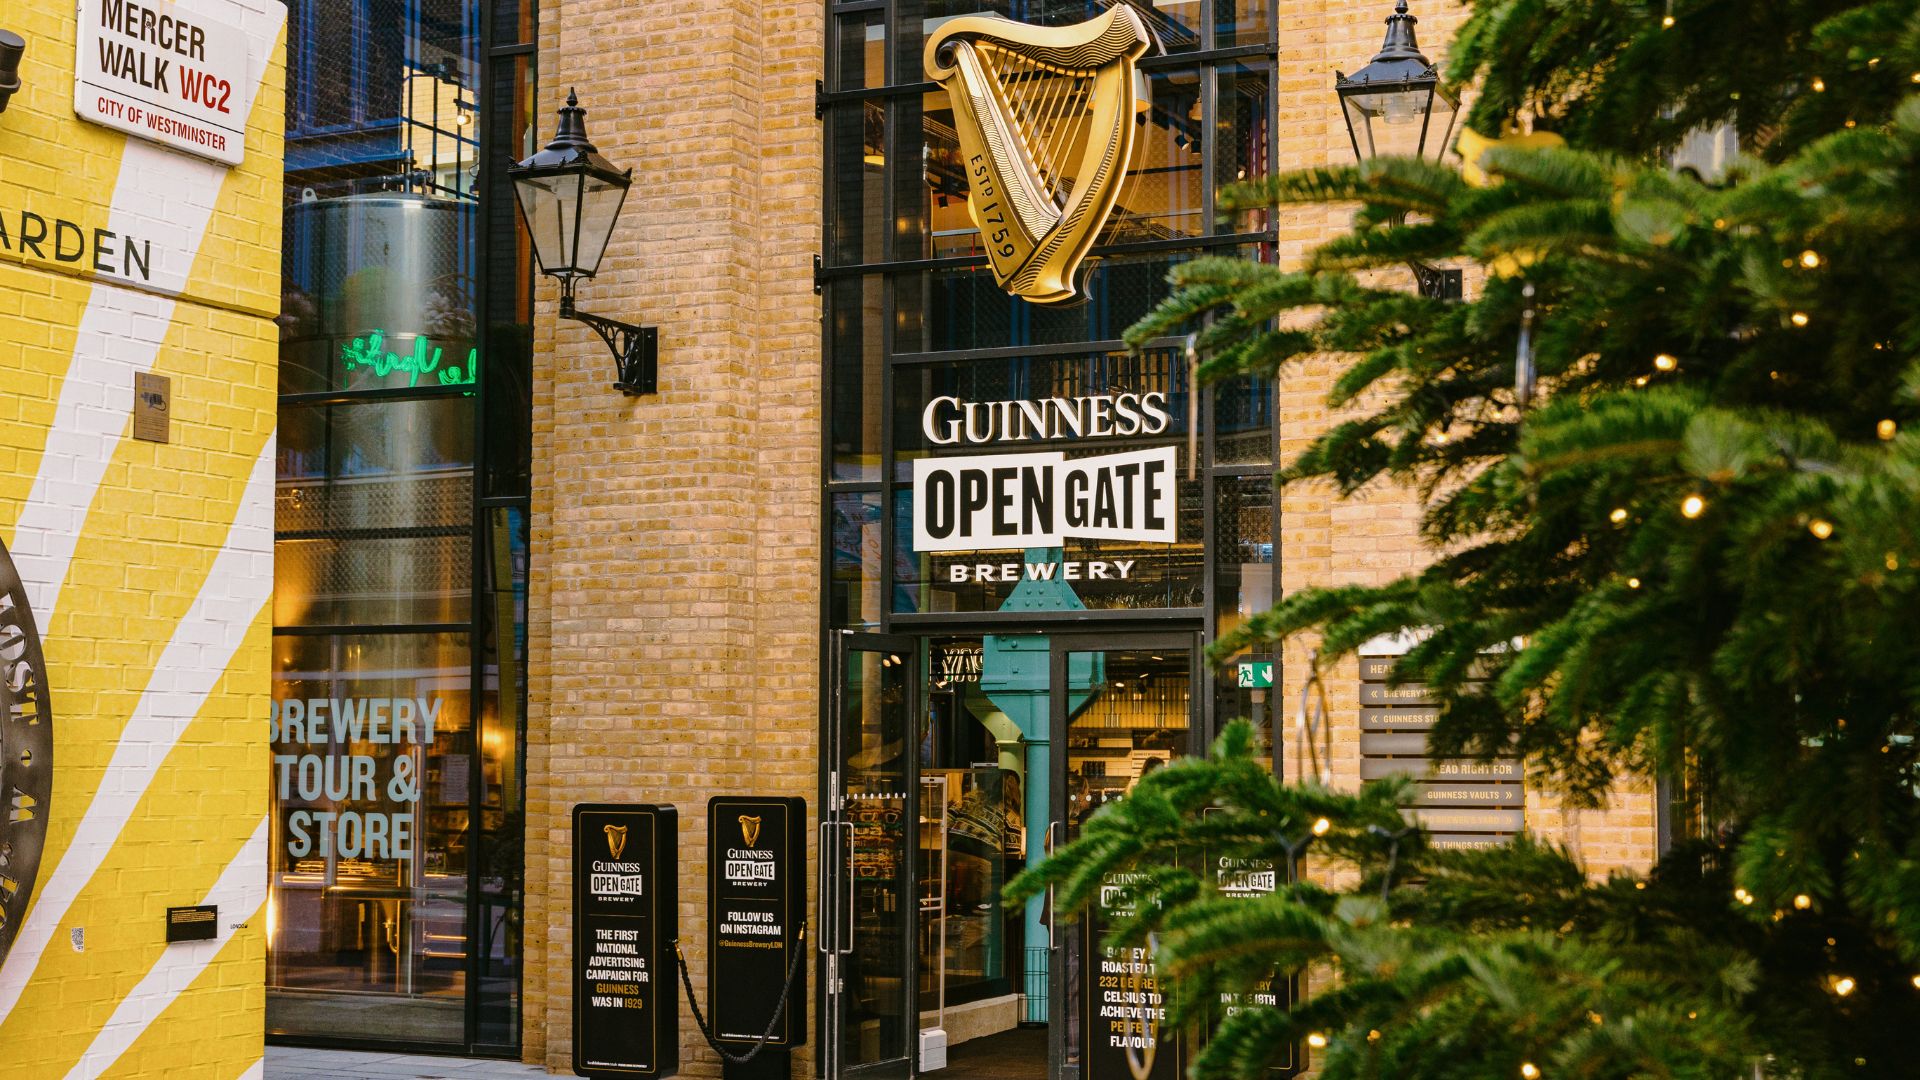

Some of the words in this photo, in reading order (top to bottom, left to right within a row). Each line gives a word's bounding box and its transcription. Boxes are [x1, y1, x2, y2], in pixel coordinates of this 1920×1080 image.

[101, 0, 206, 62] MERCER
[99, 37, 170, 94] WALK
[180, 65, 232, 115] WC2
[98, 97, 124, 119] CITY
[128, 106, 143, 125] OF
[147, 112, 226, 152] WESTMINSTER
[983, 202, 1015, 258] 1759
[923, 392, 1171, 445] GUINNESS
[925, 465, 1054, 540] OPEN
[1065, 459, 1165, 532] GATE
[950, 560, 1135, 583] BREWERY
[1370, 664, 1396, 674] HEA
[1383, 690, 1421, 698] BREWERY
[1383, 714, 1423, 724] GUINNESS
[1461, 764, 1490, 775] RIGHT
[1493, 764, 1512, 775] FOR
[274, 754, 377, 801] TOUR
[387, 754, 421, 802] &
[1427, 791, 1468, 800] GUINNESS
[1469, 791, 1500, 800] VAULTS
[288, 811, 415, 859] STORE
[1443, 841, 1472, 850] THINGS
[727, 848, 774, 860] GUINNESS
[592, 860, 641, 873] GUINNESS
[728, 862, 753, 877] OPEN
[754, 863, 773, 878] GATE
[593, 876, 619, 892] OPEN
[620, 877, 640, 892] GATE
[1250, 873, 1273, 889] GATE
[727, 911, 761, 922] FOLLOW
[762, 912, 774, 923] US
[595, 928, 613, 940] THE
[614, 929, 639, 941] FIRST
[720, 923, 733, 934] ON
[733, 924, 782, 936] INSTAGRAM
[596, 942, 639, 955] NATIONAL
[589, 956, 645, 969] ADVERTISING
[1102, 961, 1148, 974] ROASTED
[586, 969, 632, 981] CAMPAIGN
[633, 971, 649, 983] FOR
[1099, 975, 1118, 988] 232
[596, 983, 639, 995] GUINNESS
[592, 996, 612, 1008] WAS
[613, 997, 623, 1008] IN
[624, 998, 643, 1009] 1929
[1104, 990, 1147, 1004] CELSIUS
[1147, 992, 1162, 1005] TO
[1220, 992, 1232, 1004] IN
[1254, 993, 1276, 1006] 18TH
[1100, 1005, 1143, 1019] ACHIEVE
[1144, 1007, 1166, 1020] THE
